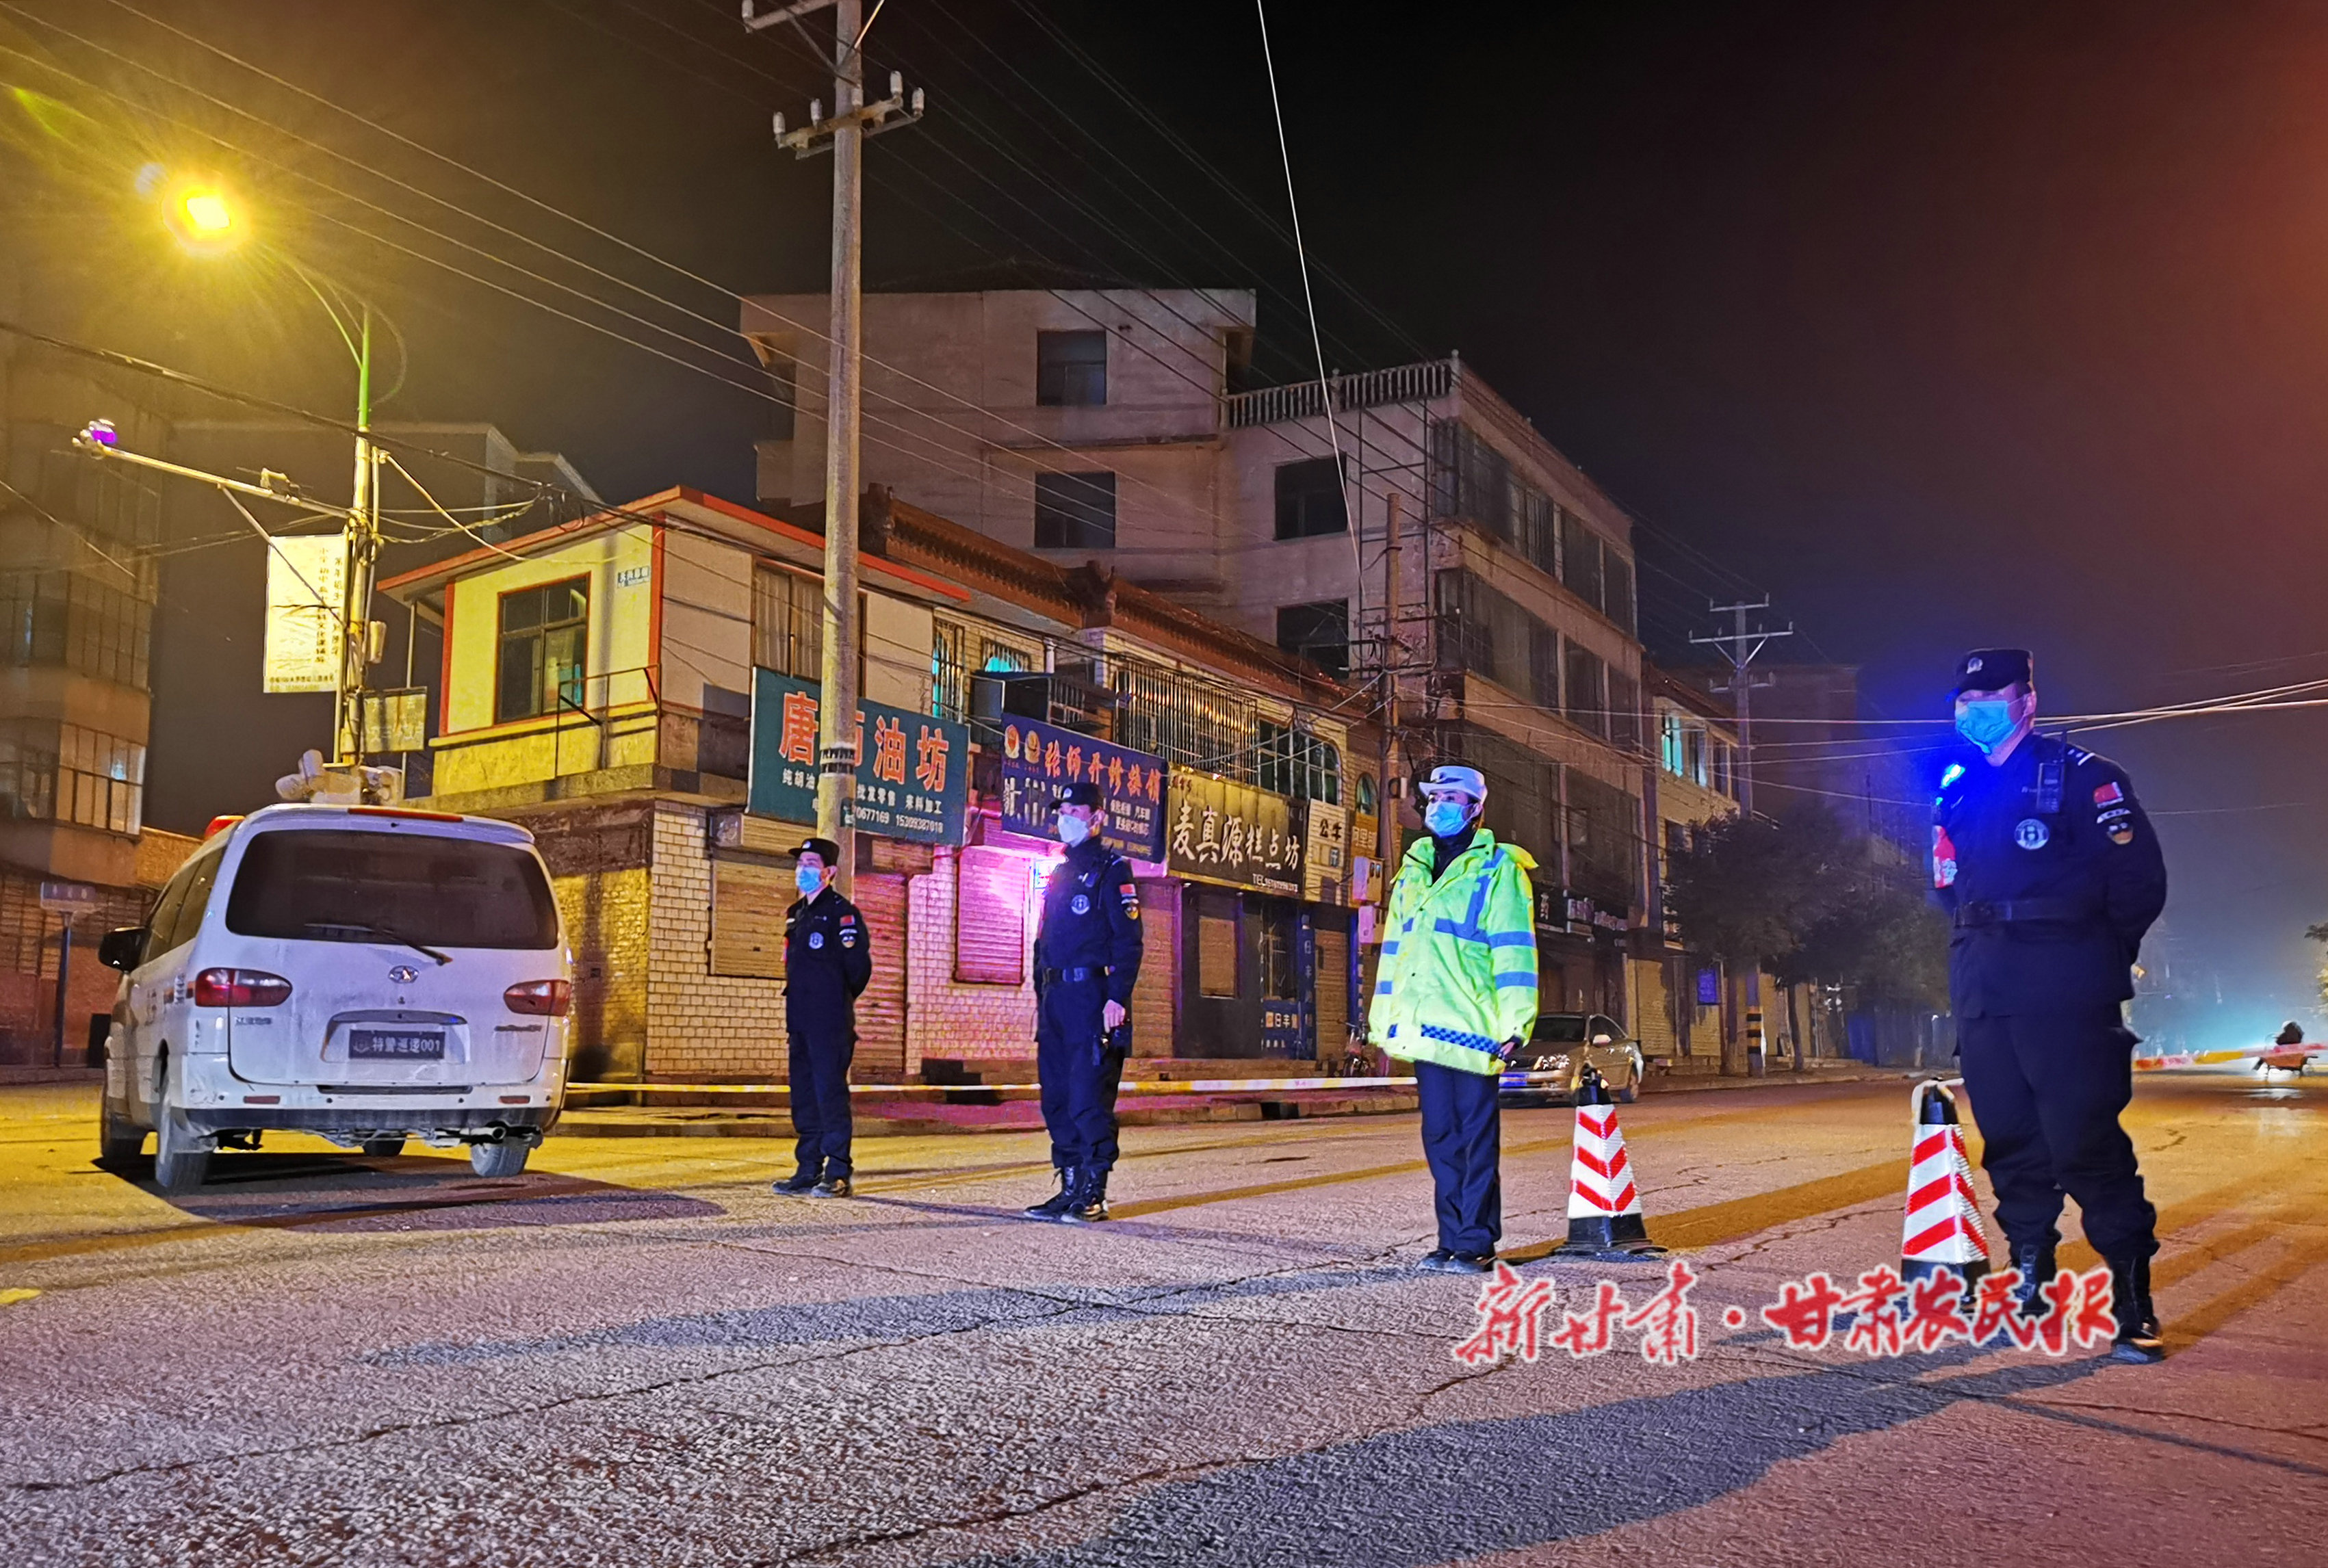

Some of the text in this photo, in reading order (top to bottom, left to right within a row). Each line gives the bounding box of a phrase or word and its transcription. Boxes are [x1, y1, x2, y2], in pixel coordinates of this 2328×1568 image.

[778, 690, 950, 792] 唐油坊
[857, 783, 943, 814] 批发零售 来料加工
[1172, 798, 1301, 872] 麦真源糕点坊
[1319, 818, 1342, 841] 公牛
